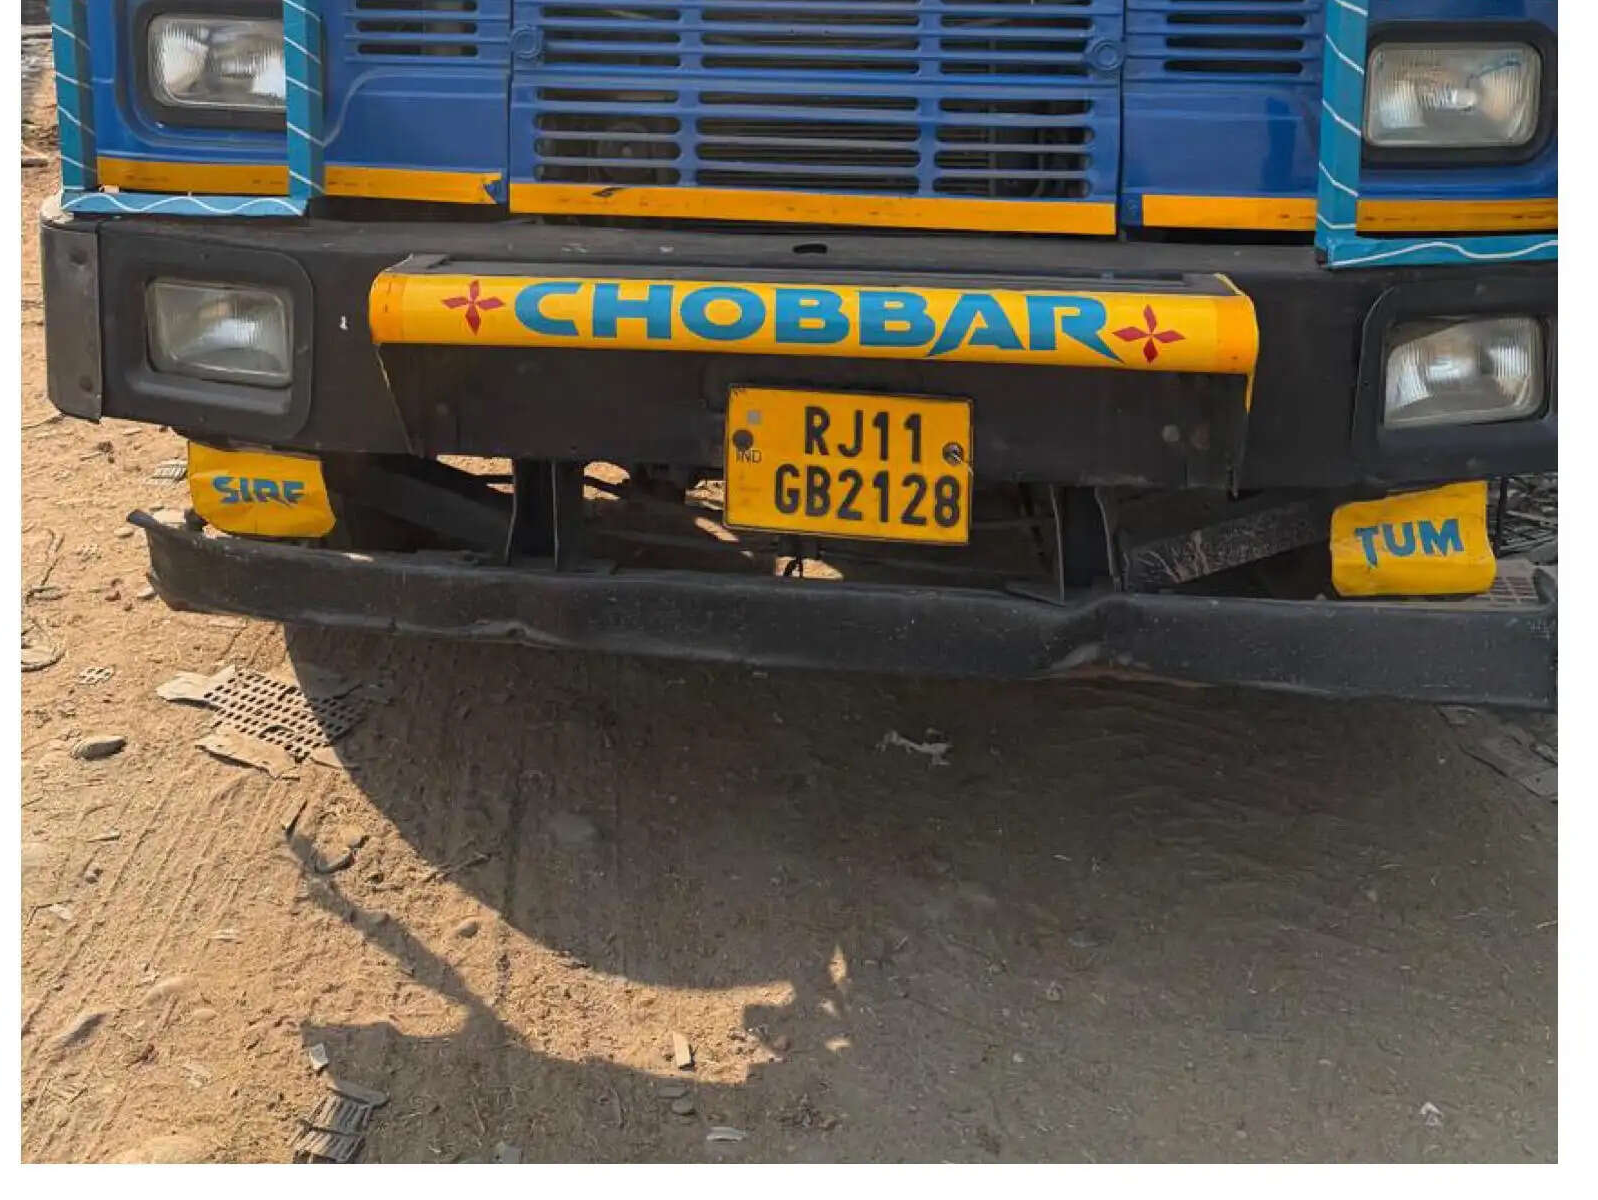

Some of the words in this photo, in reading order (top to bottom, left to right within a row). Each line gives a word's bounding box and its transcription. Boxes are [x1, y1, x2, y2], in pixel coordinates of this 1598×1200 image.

[514, 281, 1123, 365] CHOBBAR
[804, 406, 922, 464] RJ11
[774, 463, 961, 528] GB2128
[1354, 517, 1465, 569] TUM
